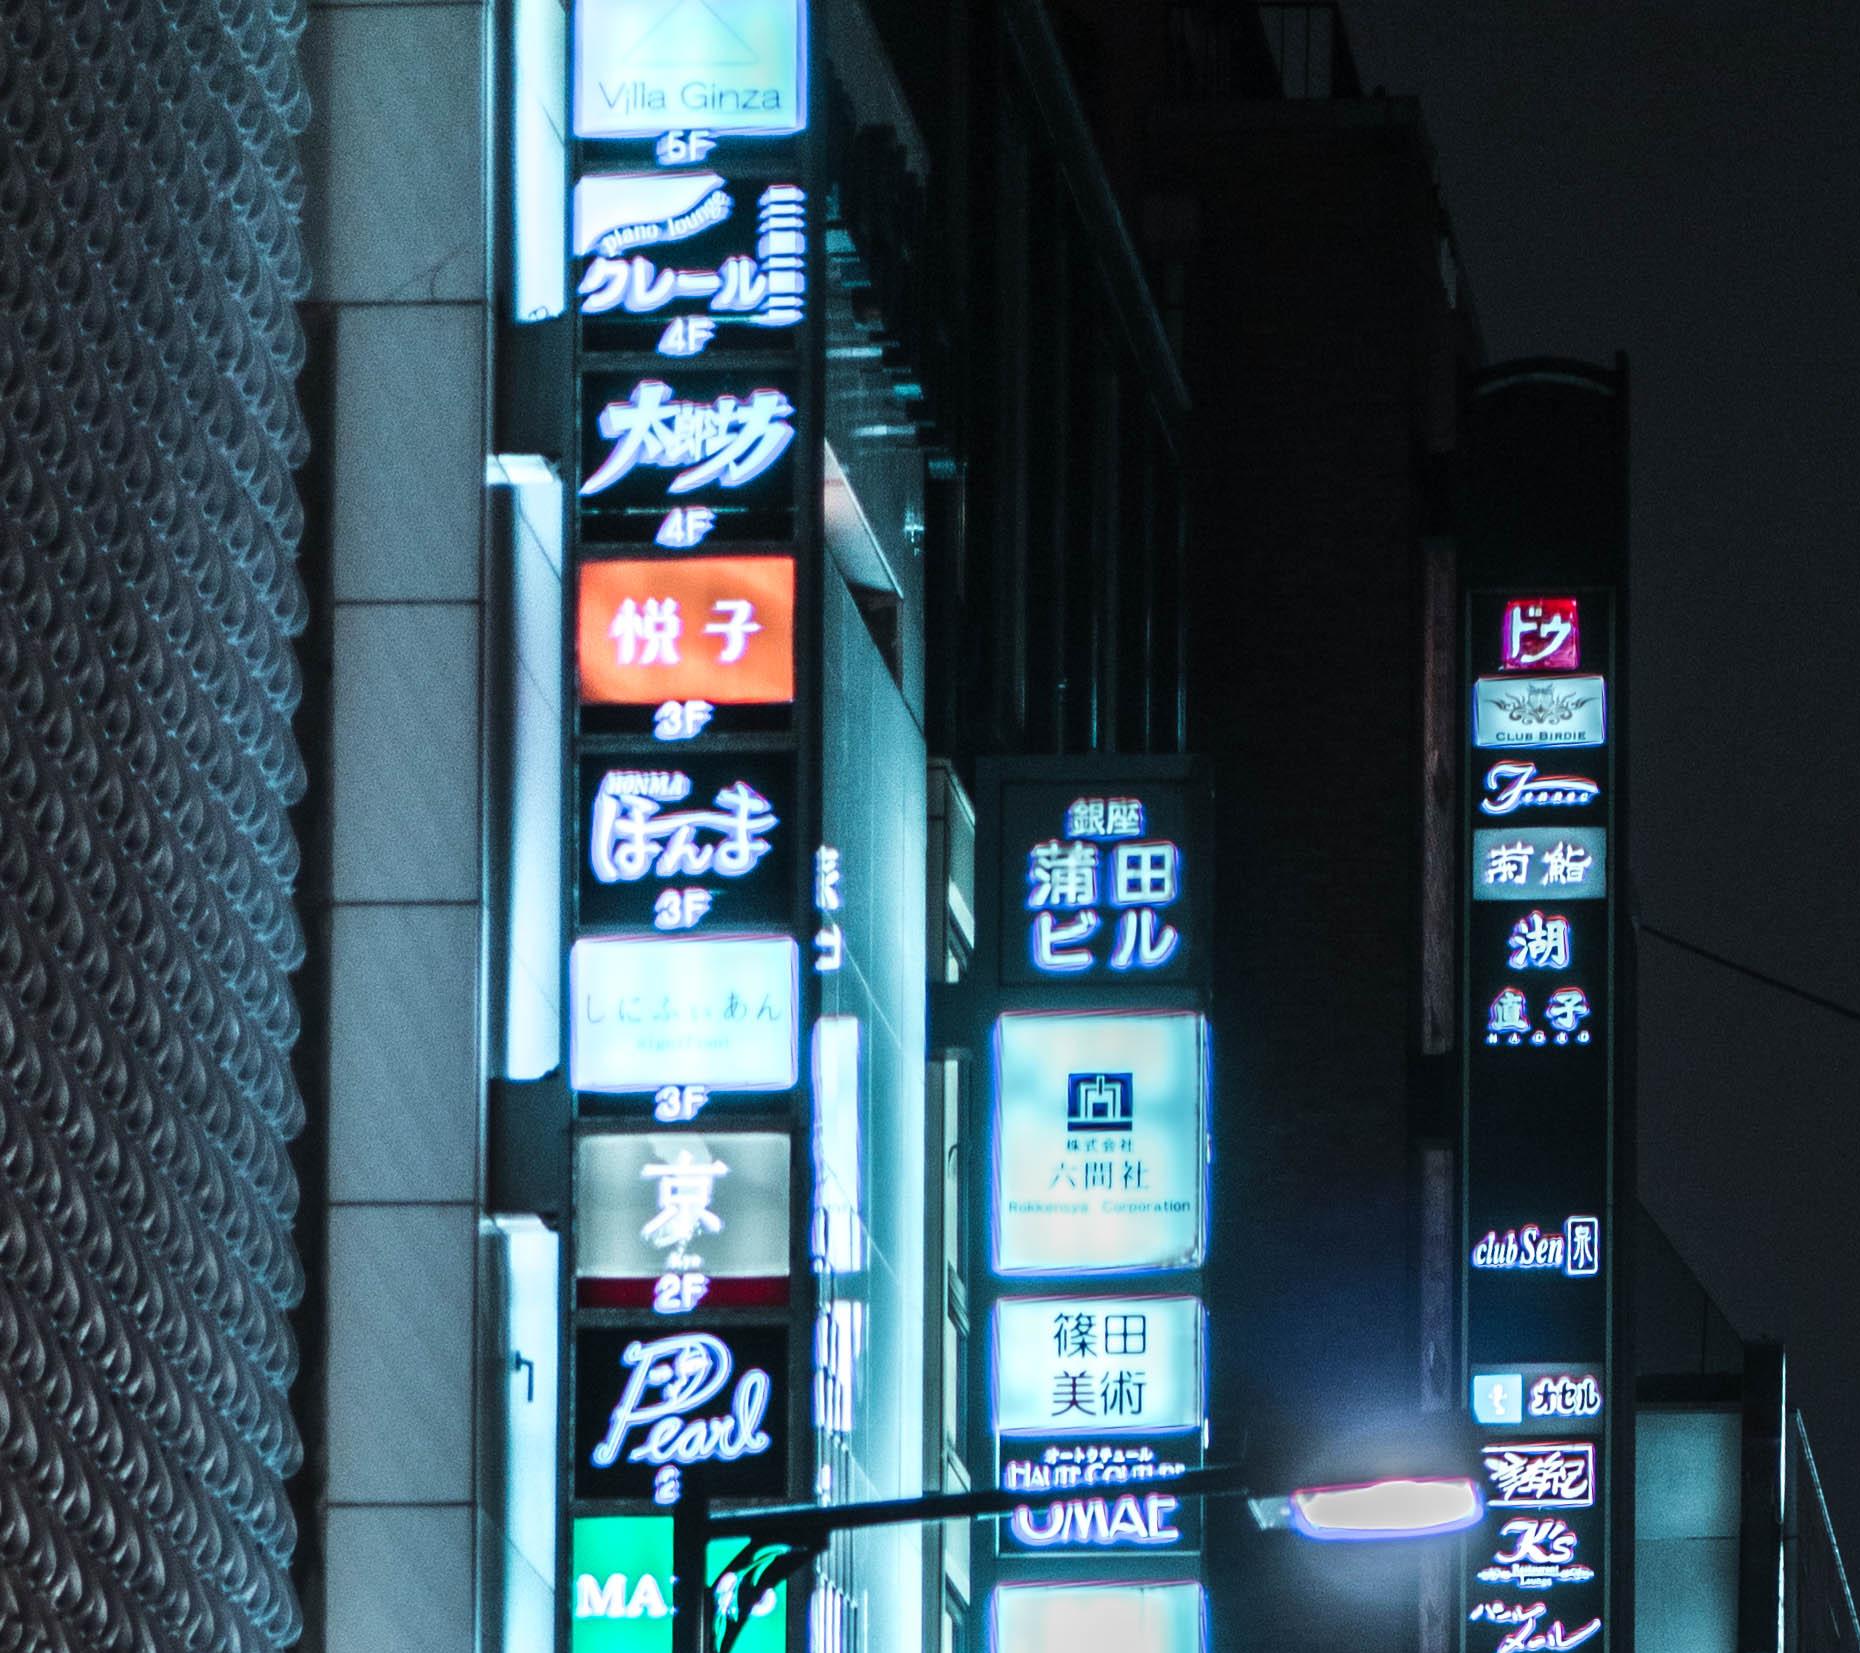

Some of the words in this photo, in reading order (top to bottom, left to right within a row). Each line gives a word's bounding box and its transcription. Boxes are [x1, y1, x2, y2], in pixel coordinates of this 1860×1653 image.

[681, 82, 782, 112] Ginza
[656, 131, 715, 164] 5F
[580, 256, 771, 313] クレール
[658, 318, 715, 357] 4F
[656, 507, 715, 547] 4F
[654, 701, 713, 739] 3F
[1495, 731, 1534, 743] CLUB
[1539, 730, 1588, 742] BIRDIE
[1068, 799, 1143, 838] 銀座
[1029, 839, 1178, 907] 蒲田
[1037, 913, 1178, 971] ビル
[1473, 1229, 1518, 1270] club
[1519, 1223, 1565, 1269] Sen
[654, 1274, 707, 1312] 2F
[593, 1332, 773, 1463] Pearl
[1051, 1371, 1147, 1416] 美術
